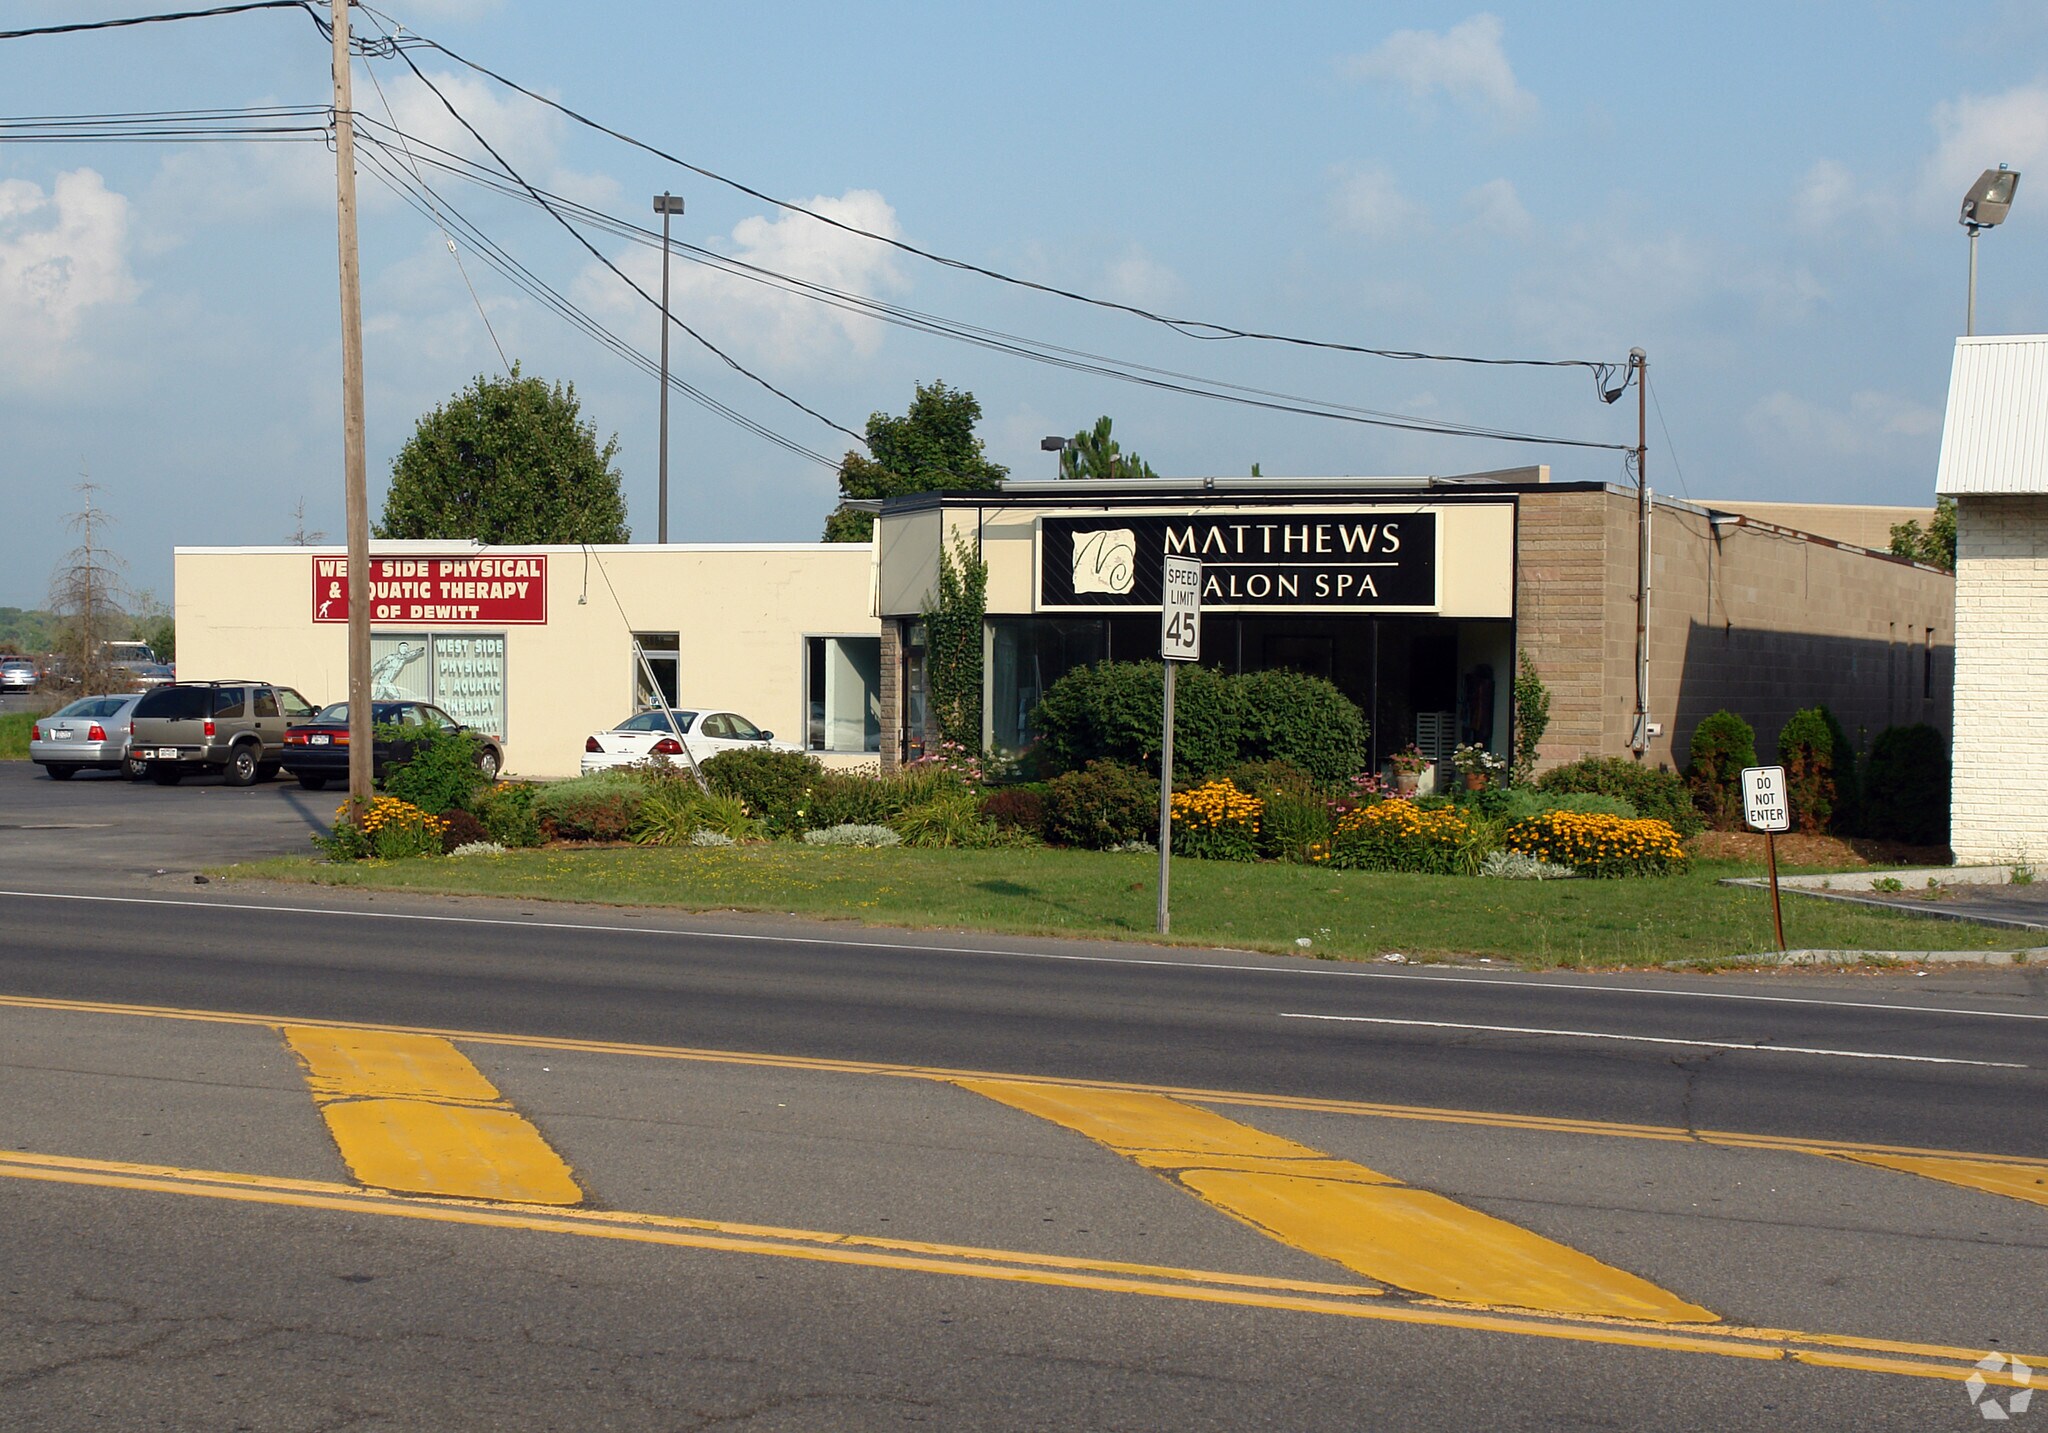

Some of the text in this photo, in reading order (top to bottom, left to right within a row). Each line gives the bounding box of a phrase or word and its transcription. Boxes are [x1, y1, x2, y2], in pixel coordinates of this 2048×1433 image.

[1164, 524, 1400, 554] MATTHEWS
[319, 560, 541, 577] WE SIDE PHYSICAL
[1168, 568, 1199, 587] SPEED
[1203, 574, 1378, 597] ALON SPA
[329, 581, 529, 600] & QUATIC THERAPY
[1170, 589, 1194, 606] LIMIT
[376, 604, 479, 619] OF DEWITT
[1166, 611, 1196, 648] 45
[436, 639, 503, 654] WEST SIDE
[440, 659, 498, 673] PHYSICAL
[453, 678, 501, 694] AQUATIC
[443, 699, 496, 713] THERAPY
[1757, 777, 1771, 789] DO
[1756, 793, 1775, 805] NOT
[1750, 809, 1784, 821] ENTER
